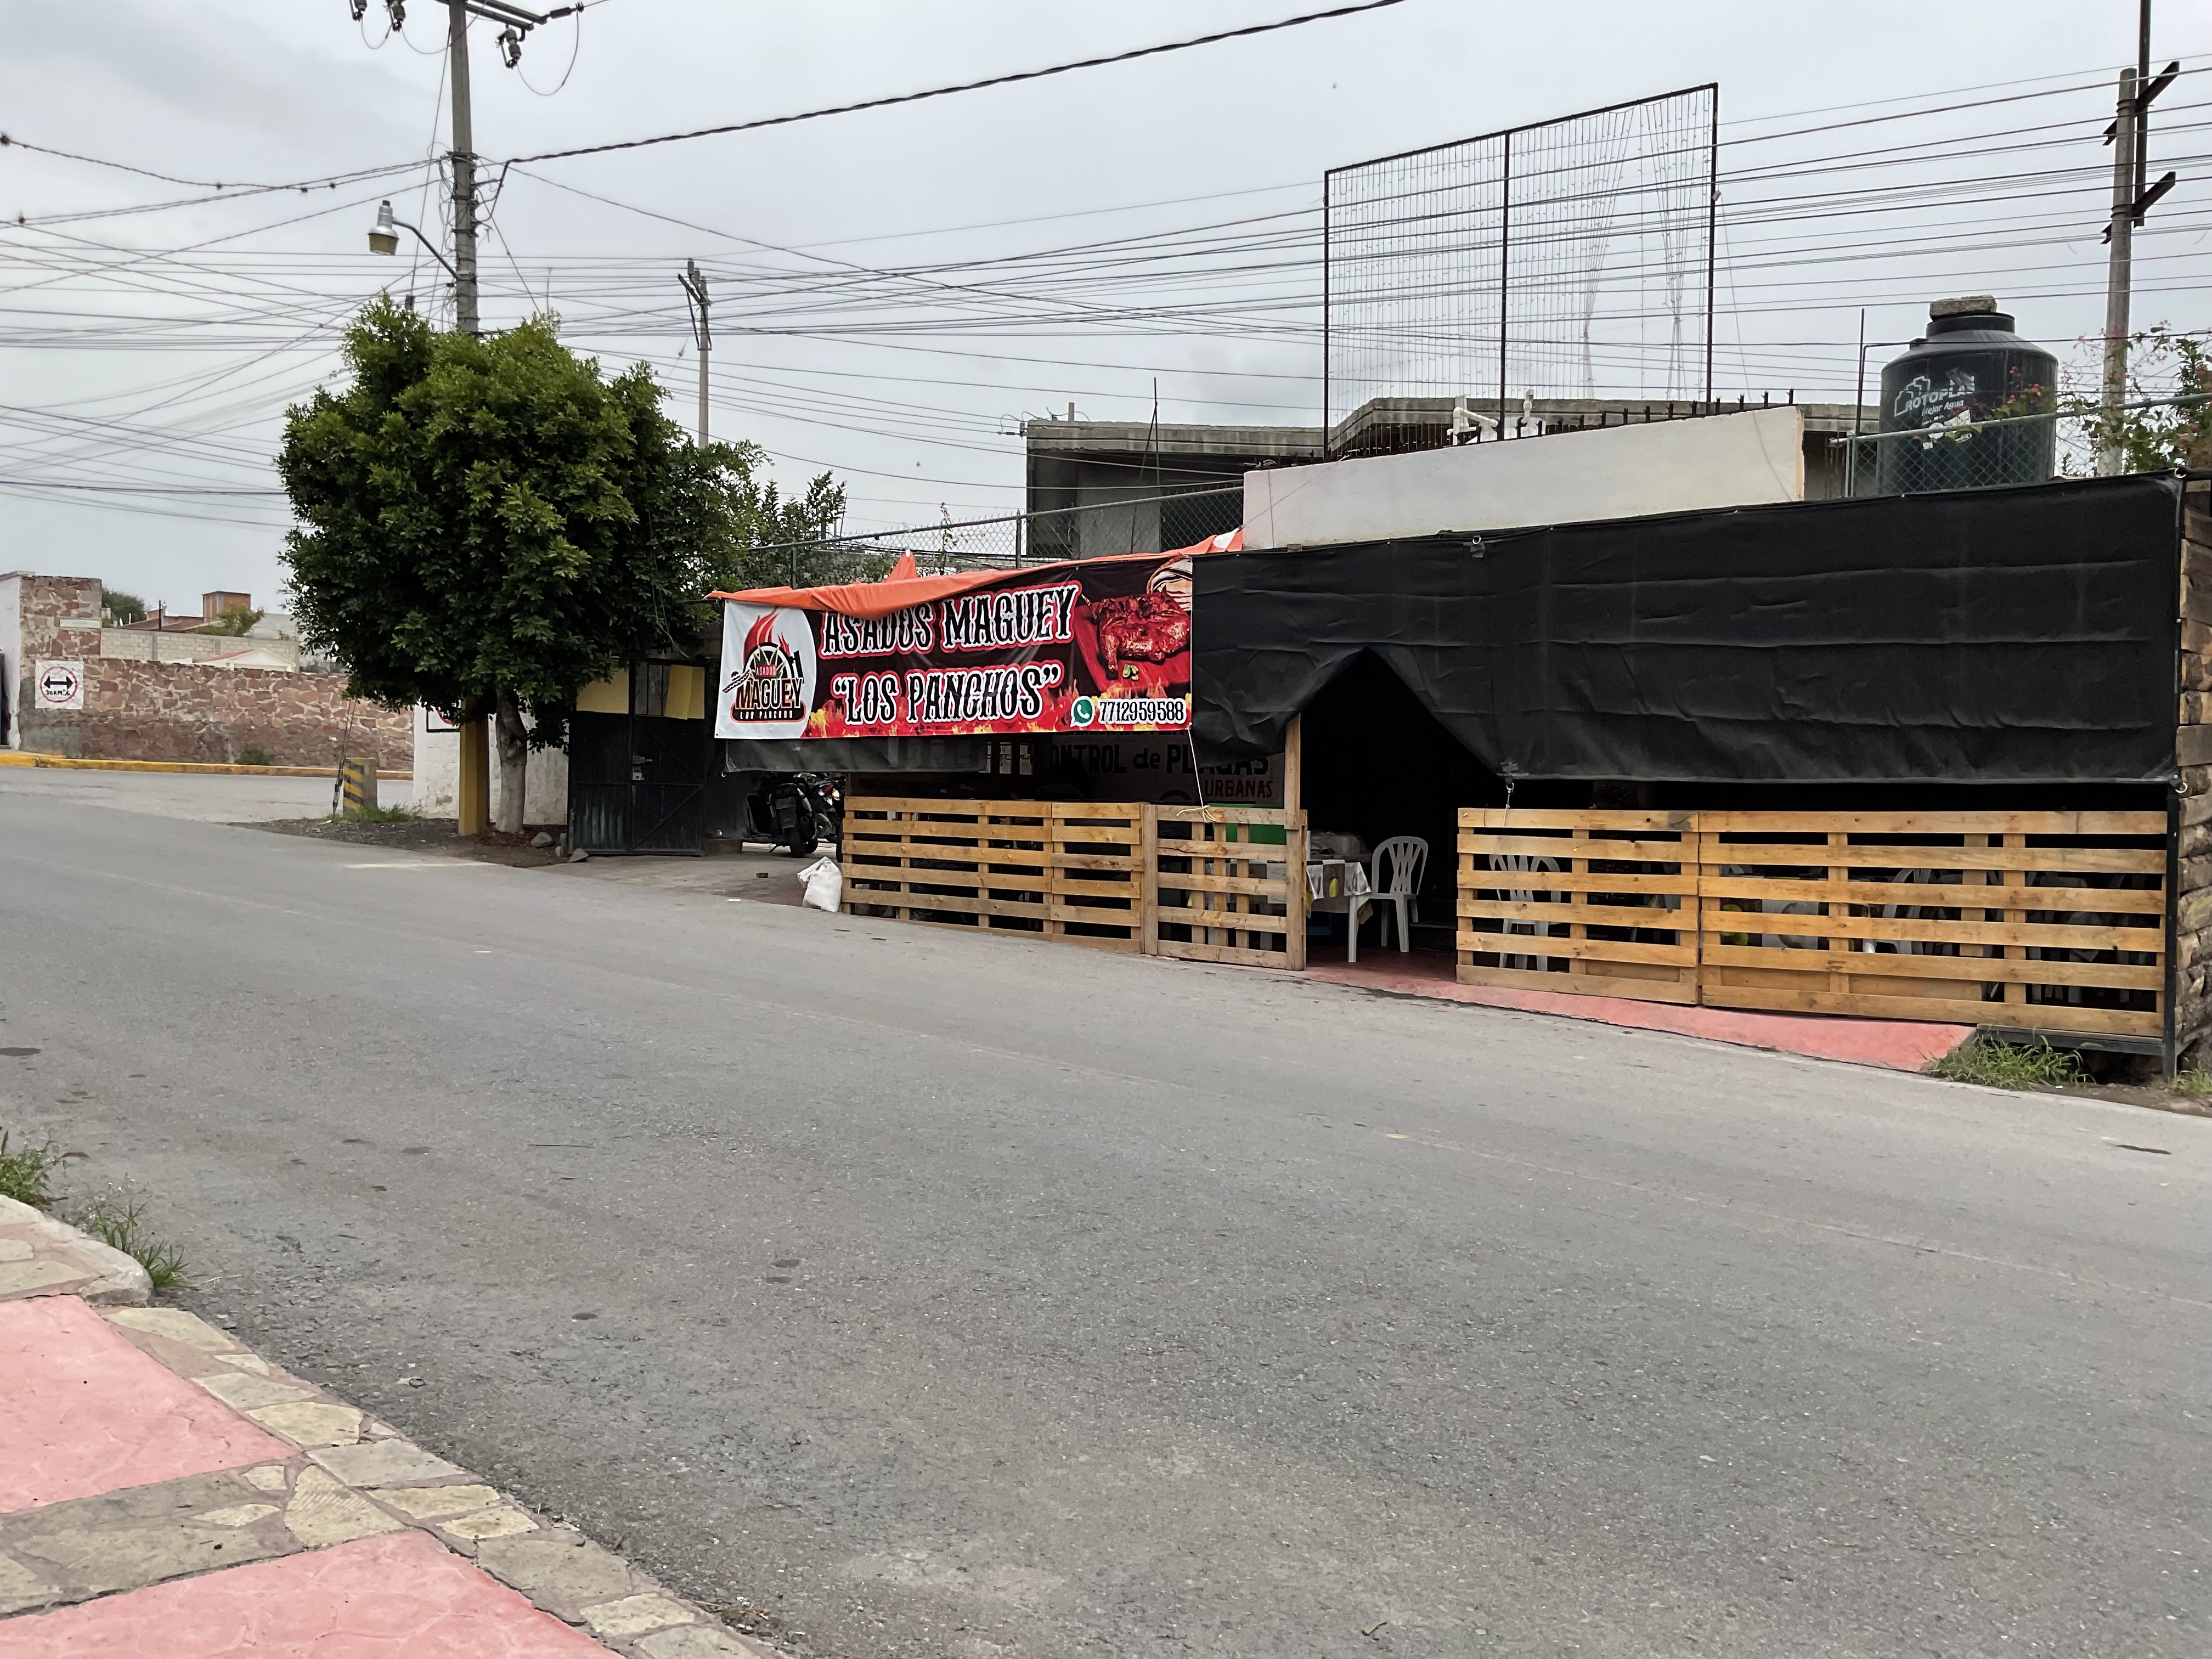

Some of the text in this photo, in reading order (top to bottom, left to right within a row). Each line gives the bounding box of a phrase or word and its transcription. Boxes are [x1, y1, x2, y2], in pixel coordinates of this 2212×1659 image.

[1944, 400, 1964, 410] Agua
[822, 586, 1079, 654] ASADOS MAGUEY
[755, 665, 776, 676] ASADOS
[735, 678, 803, 710] MAGUEY
[740, 710, 793, 719] LOS PANCHOS
[1099, 701, 1184, 721] 7712959588
[1051, 744, 1127, 774] ONTROL
[1132, 748, 1160, 769] de
[1204, 780, 1273, 798] URBANAS
